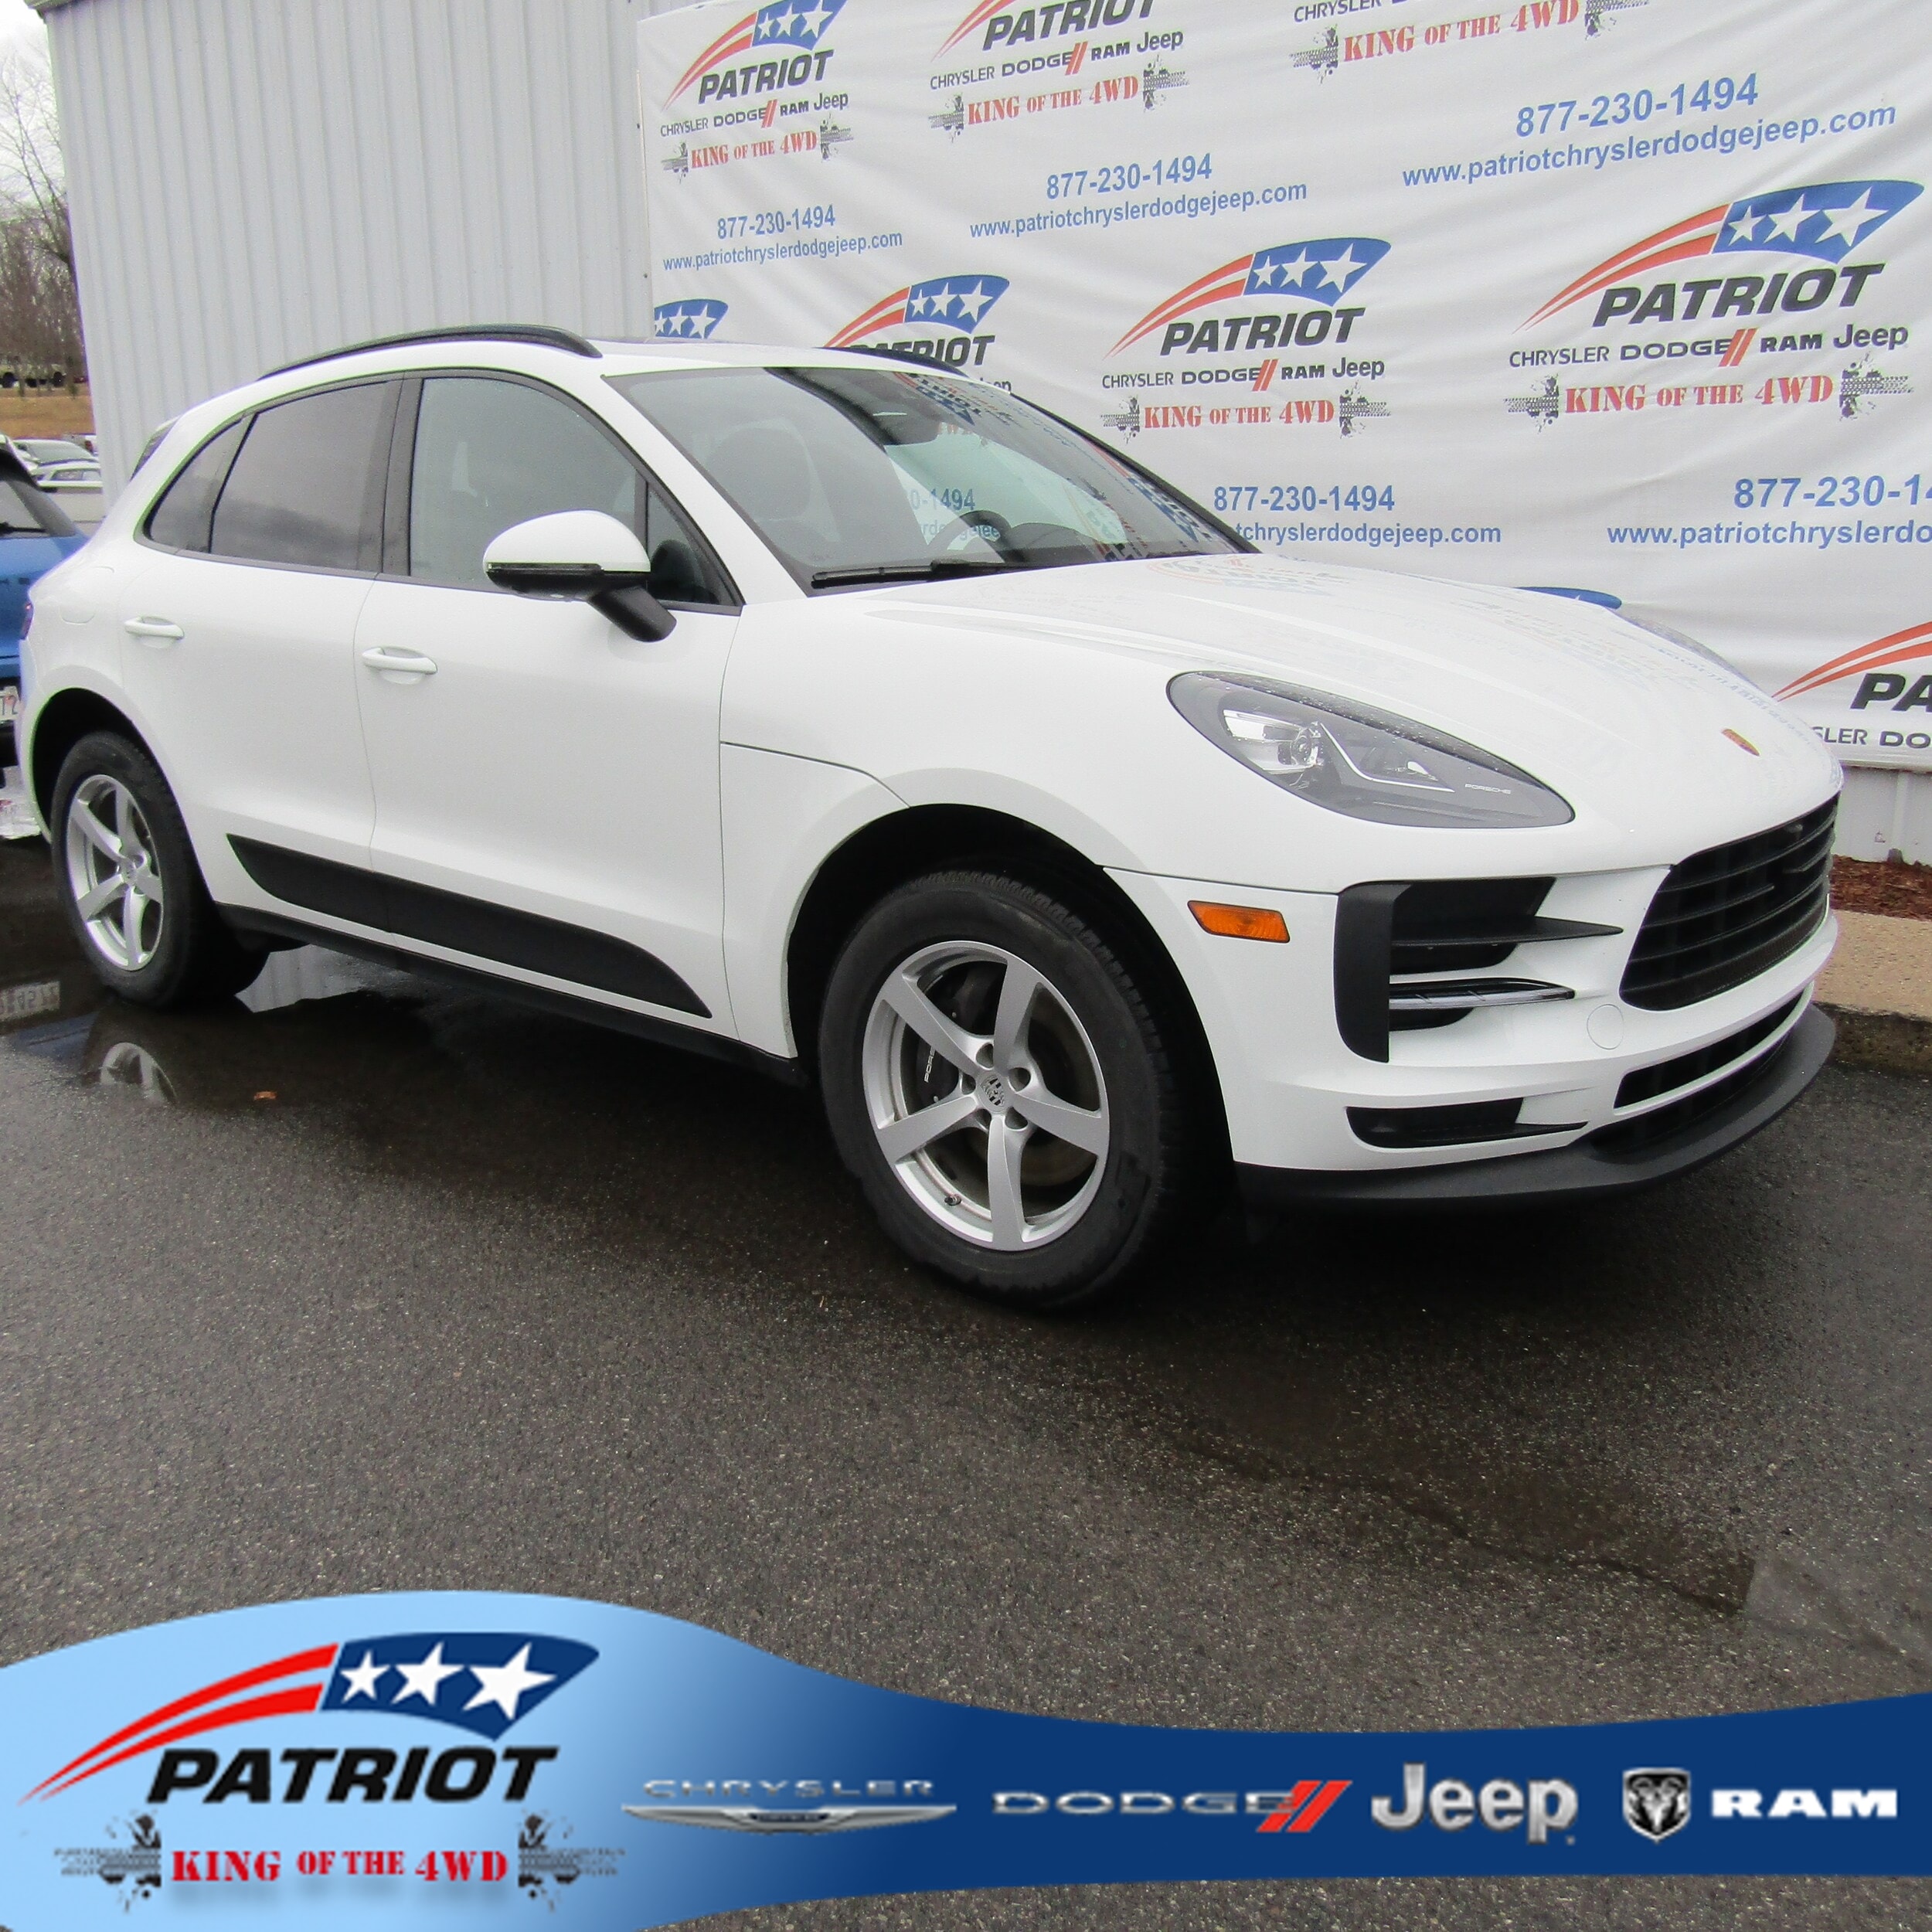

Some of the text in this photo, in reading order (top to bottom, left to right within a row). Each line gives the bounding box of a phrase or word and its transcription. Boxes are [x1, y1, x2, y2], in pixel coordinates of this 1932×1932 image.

[1344, 0, 1579, 62] KING OF THE 4WD
[698, 49, 834, 104] PATRIOT
[930, 31, 1183, 90] CHRYSLER DODGE RAM Jeep
[659, 91, 849, 137] CHRYSLER DODGE RAM Jeep
[968, 76, 1138, 125] KING OF THE 4WD
[1515, 73, 1758, 138] 877-230-1494
[691, 131, 817, 168] KING OF THE 4WD
[1403, 104, 1896, 186] www.patriotchryslerdodgejeep.com
[1046, 154, 1212, 199] 877-230-1494
[716, 204, 835, 240] 877-230-1494
[970, 182, 1307, 238] www.patriotchryslerdodgejeep.com
[663, 230, 903, 270] www.patriotchryslerdodgejeep.com
[1592, 263, 1885, 328] PATRIOT
[1159, 307, 1366, 356] PATRIOT
[1509, 323, 1908, 368] CHRYSLER DODGE RAM Jeep
[1101, 357, 1385, 389] CHRYSLER DODGE RAM Jeep
[1565, 374, 1833, 413] KING OF THE 4WD
[1144, 400, 1335, 429] KING OF THE 4WD
[1213, 485, 1396, 512] 877-230-1494
